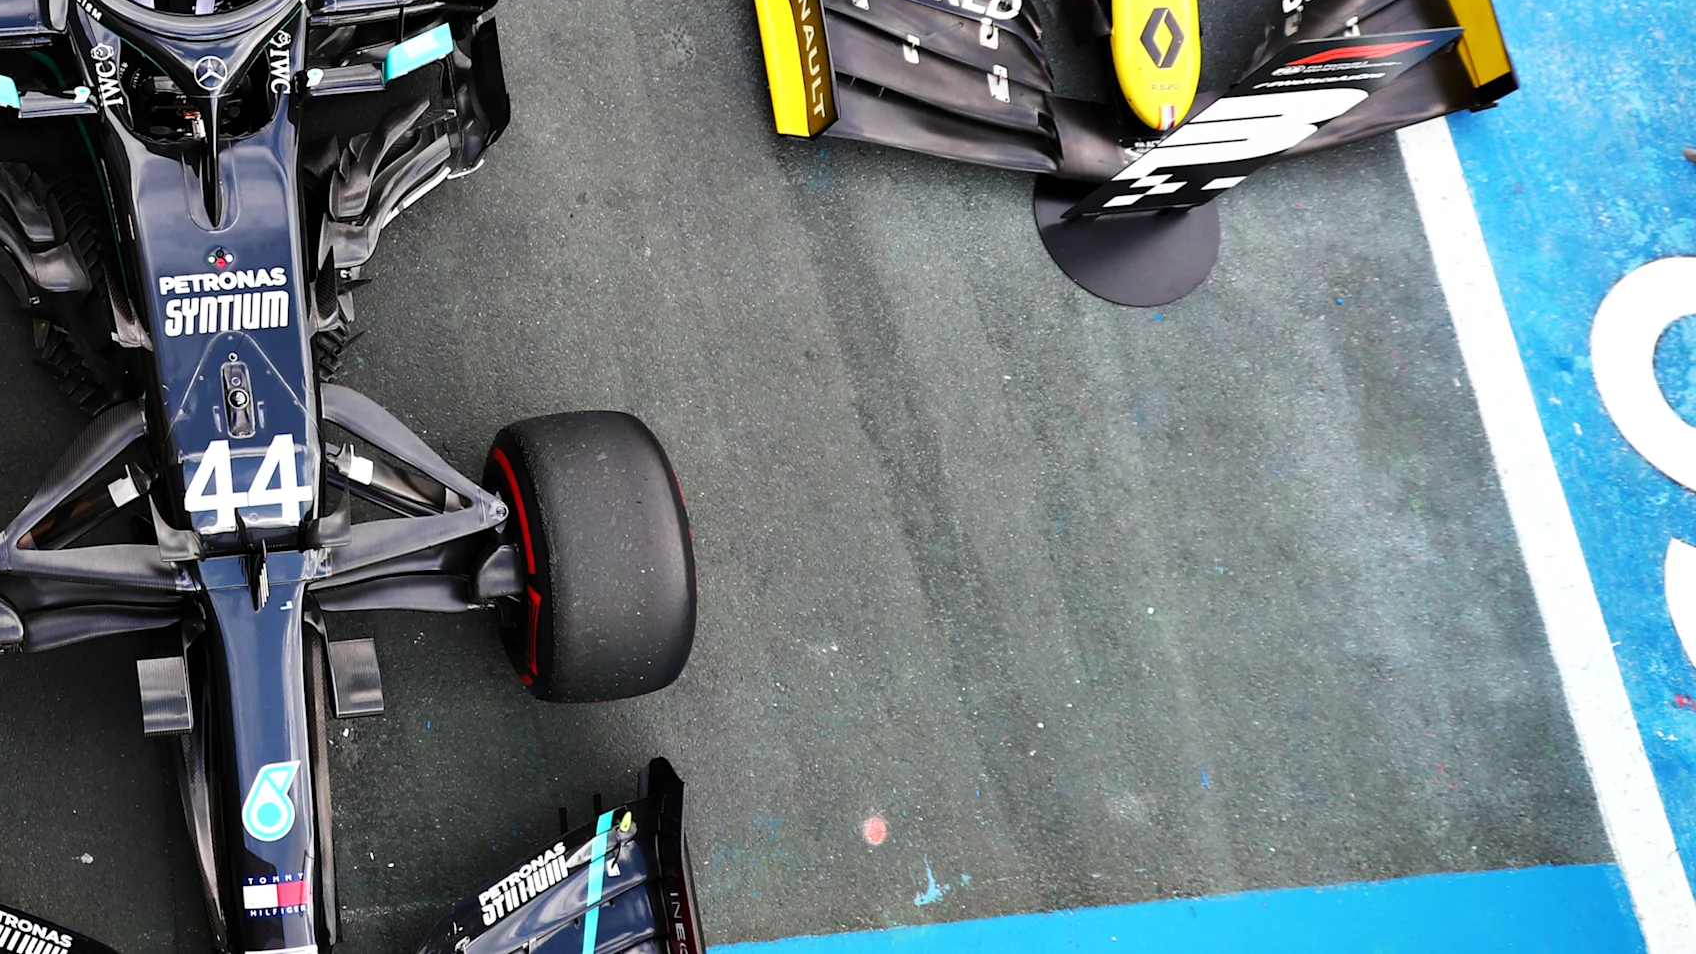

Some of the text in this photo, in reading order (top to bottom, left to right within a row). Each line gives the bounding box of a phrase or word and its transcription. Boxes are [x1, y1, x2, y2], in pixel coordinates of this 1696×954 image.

[95, 60, 124, 108] IWC
[270, 47, 292, 95] IWC
[159, 267, 288, 296] PETRONAS
[164, 290, 290, 337] SYNTIUM
[184, 433, 313, 535] 44
[248, 872, 305, 884] TOMMY
[478, 841, 566, 908] PETRONAS
[250, 904, 307, 917] HILFIGER
[670, 891, 690, 954] INE
